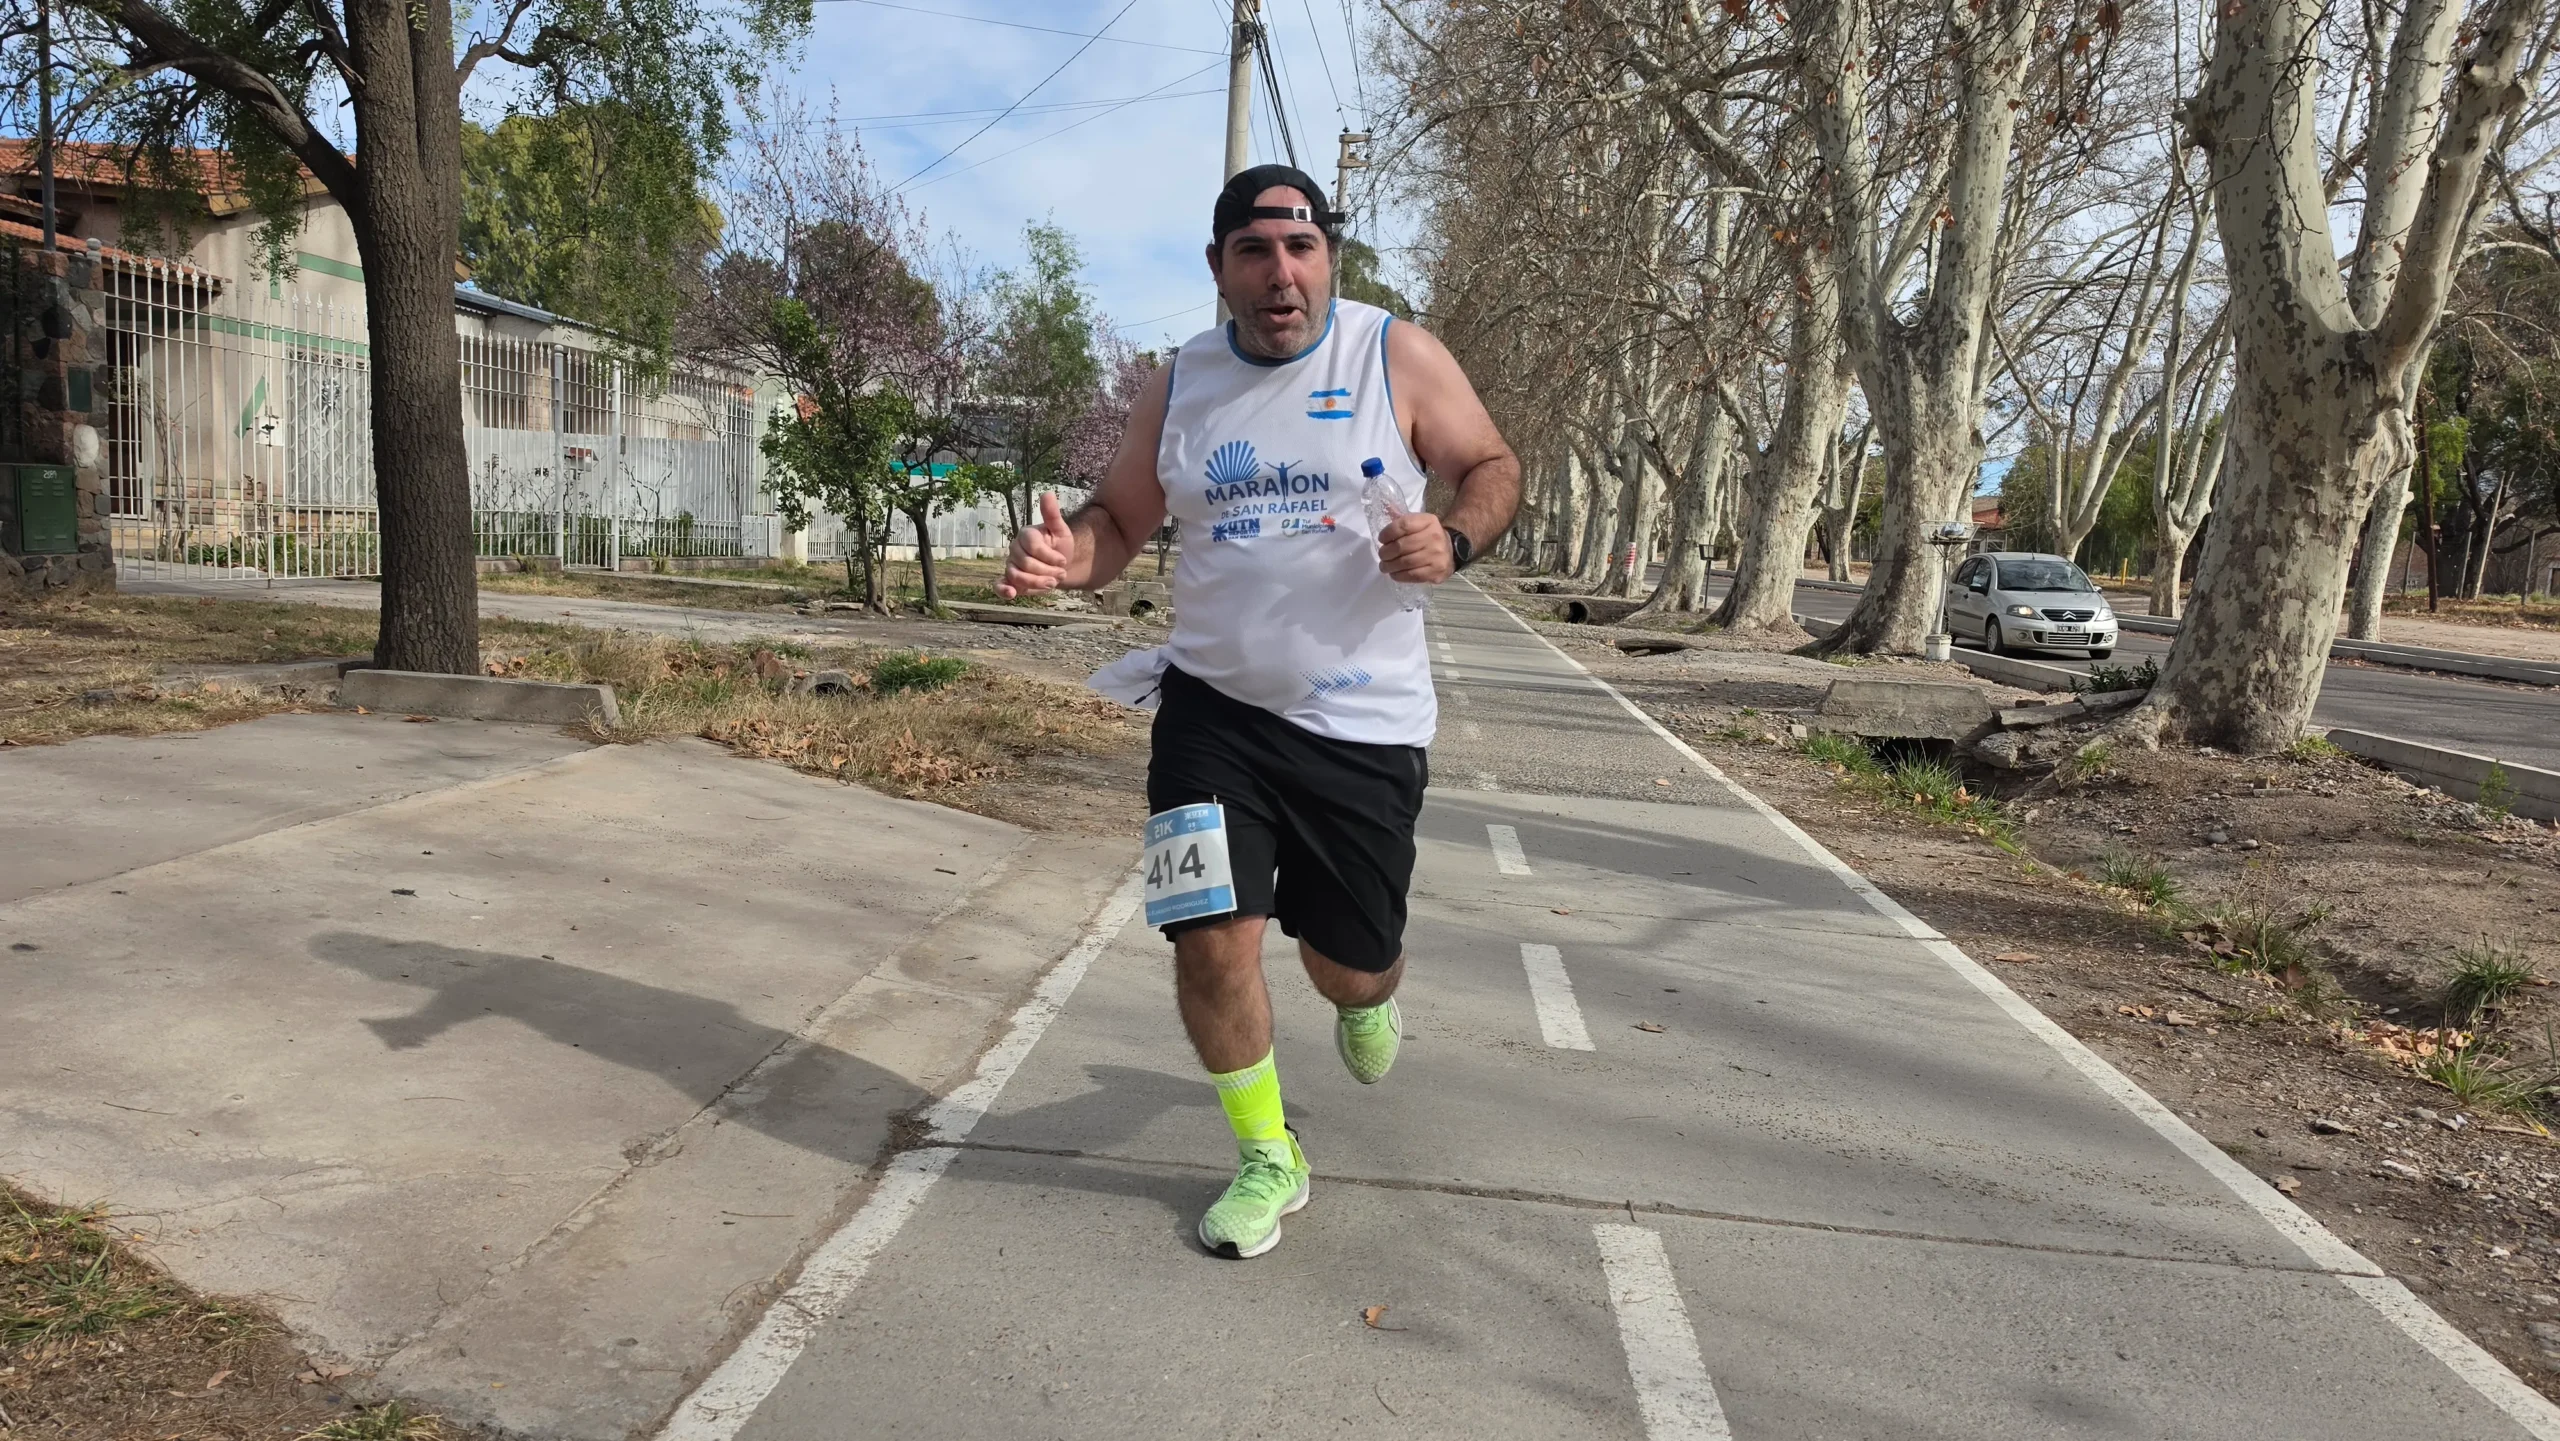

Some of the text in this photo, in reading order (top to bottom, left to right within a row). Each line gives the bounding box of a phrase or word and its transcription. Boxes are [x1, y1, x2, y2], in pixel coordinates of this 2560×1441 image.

[1221, 499, 1328, 519] DE SAN RAFAEL
[1228, 518, 1260, 531] UTN
[1154, 820, 1174, 840] 21K
[1147, 843, 1205, 889] 414
